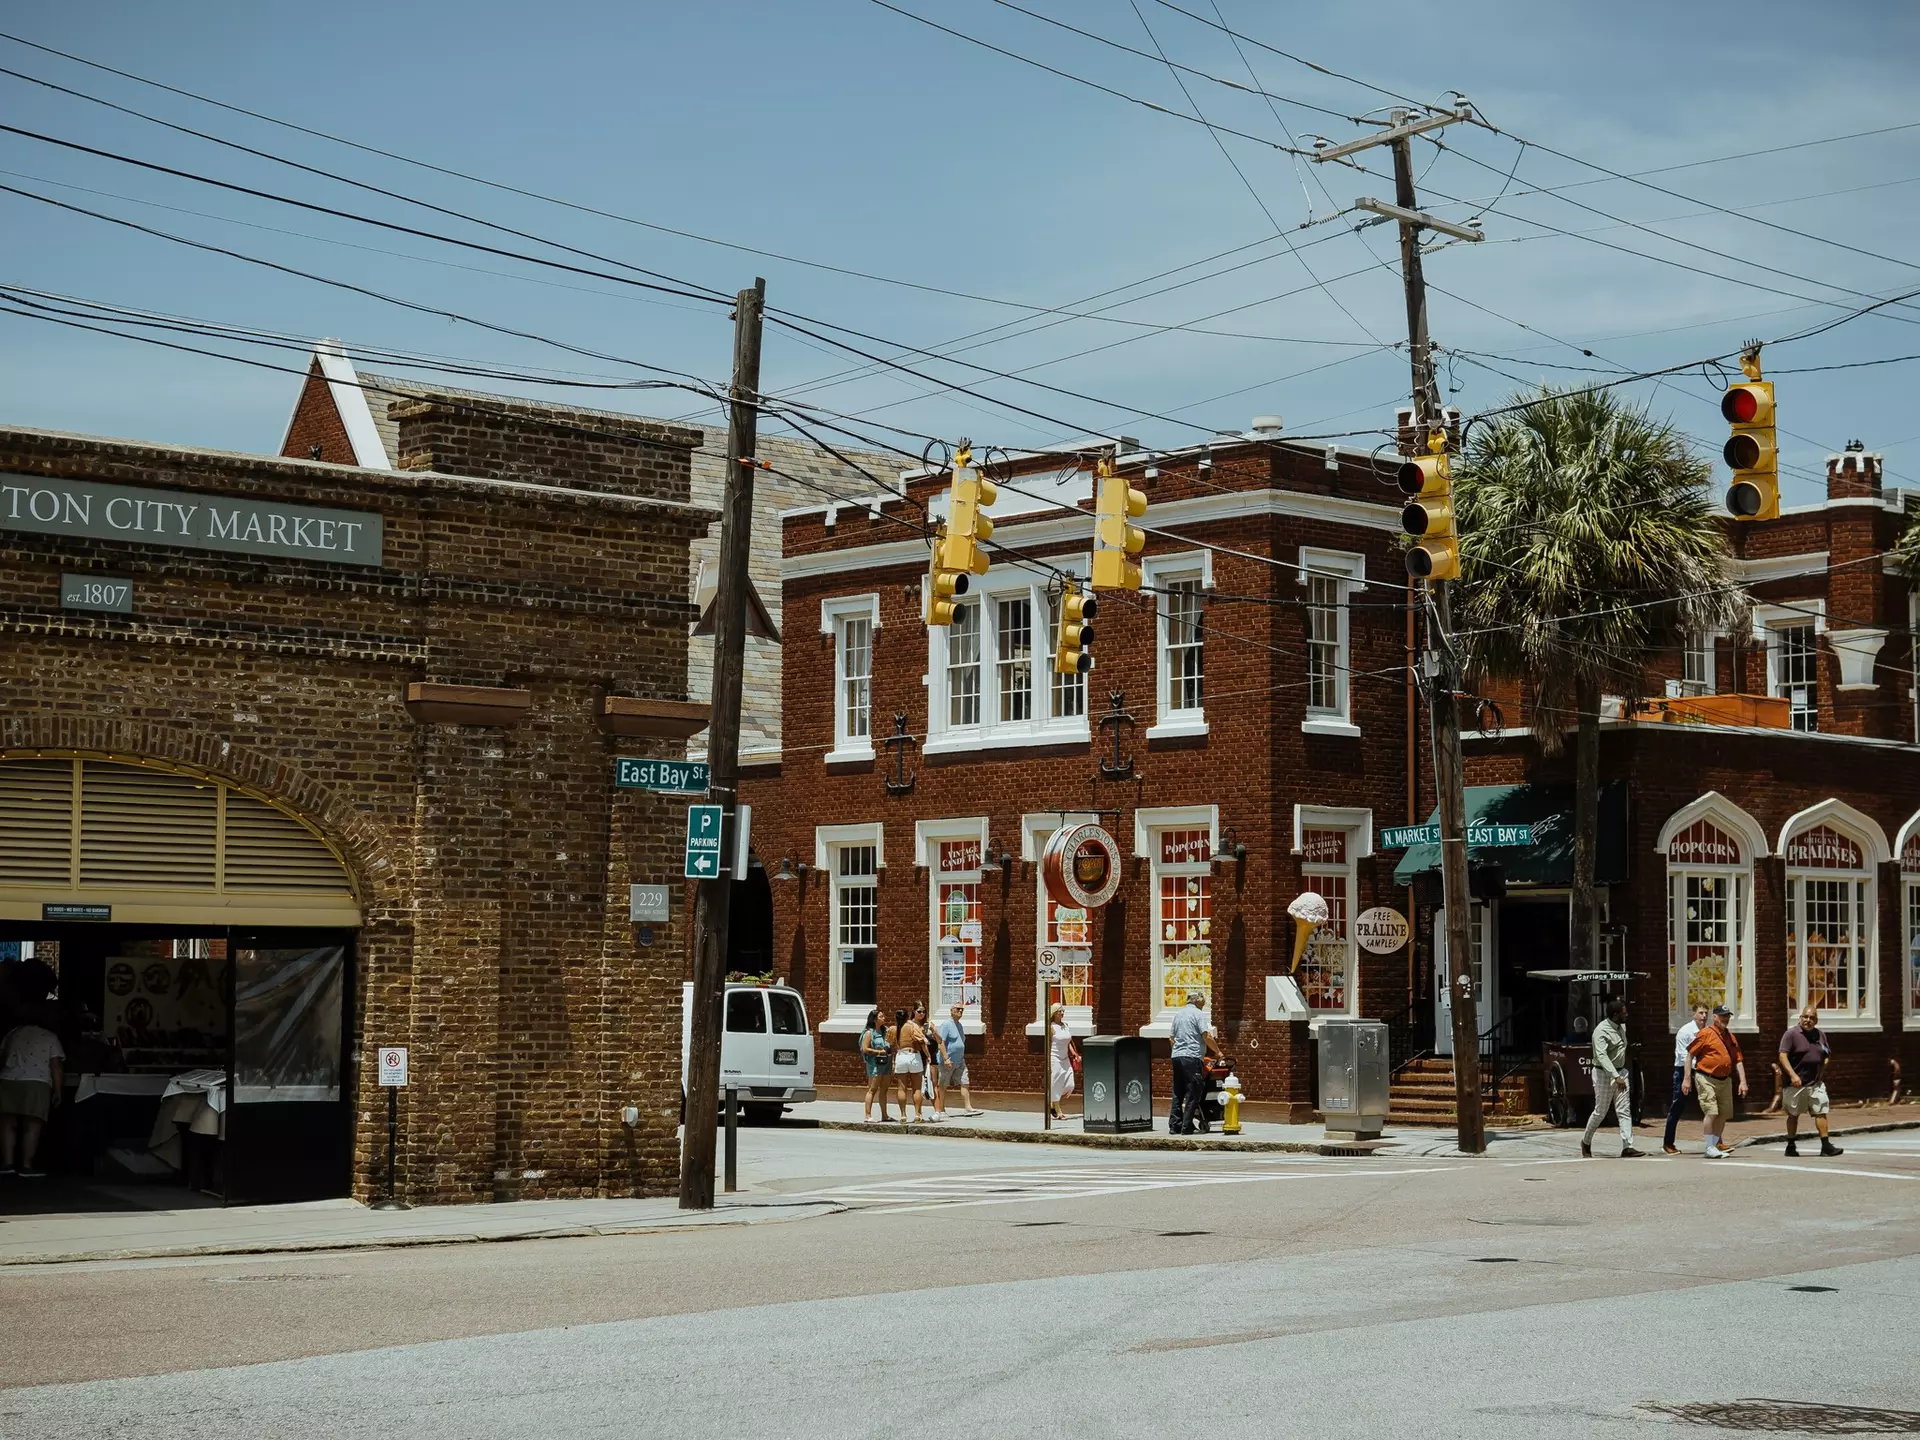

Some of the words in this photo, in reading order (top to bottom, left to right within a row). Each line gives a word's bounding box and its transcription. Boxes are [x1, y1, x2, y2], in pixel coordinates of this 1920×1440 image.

[105, 497, 198, 535] CITY
[206, 507, 362, 552] MARKET
[621, 762, 655, 784] East
[660, 764, 689, 789] Bay
[692, 766, 704, 780] St
[690, 837, 718, 848] PARKING
[1384, 831, 1395, 846] N.
[1395, 827, 1430, 843] MARKET
[1467, 828, 1493, 843] EAST
[1498, 828, 1517, 842] BAY
[1519, 829, 1528, 839] ST
[1804, 836, 1840, 846] ORIGINAL
[1165, 838, 1210, 855] POPCORN
[1302, 840, 1342, 850] SOUTHERN
[1306, 847, 1339, 857] CANDIES
[1671, 842, 1736, 858] POPCORN
[948, 846, 979, 860] VINTAGE
[1788, 845, 1857, 864] PRALINES
[942, 857, 965, 868] CANDY
[639, 892, 663, 907] 229
[1373, 911, 1391, 921] FREE
[1366, 938, 1399, 948] SAMPLES!
